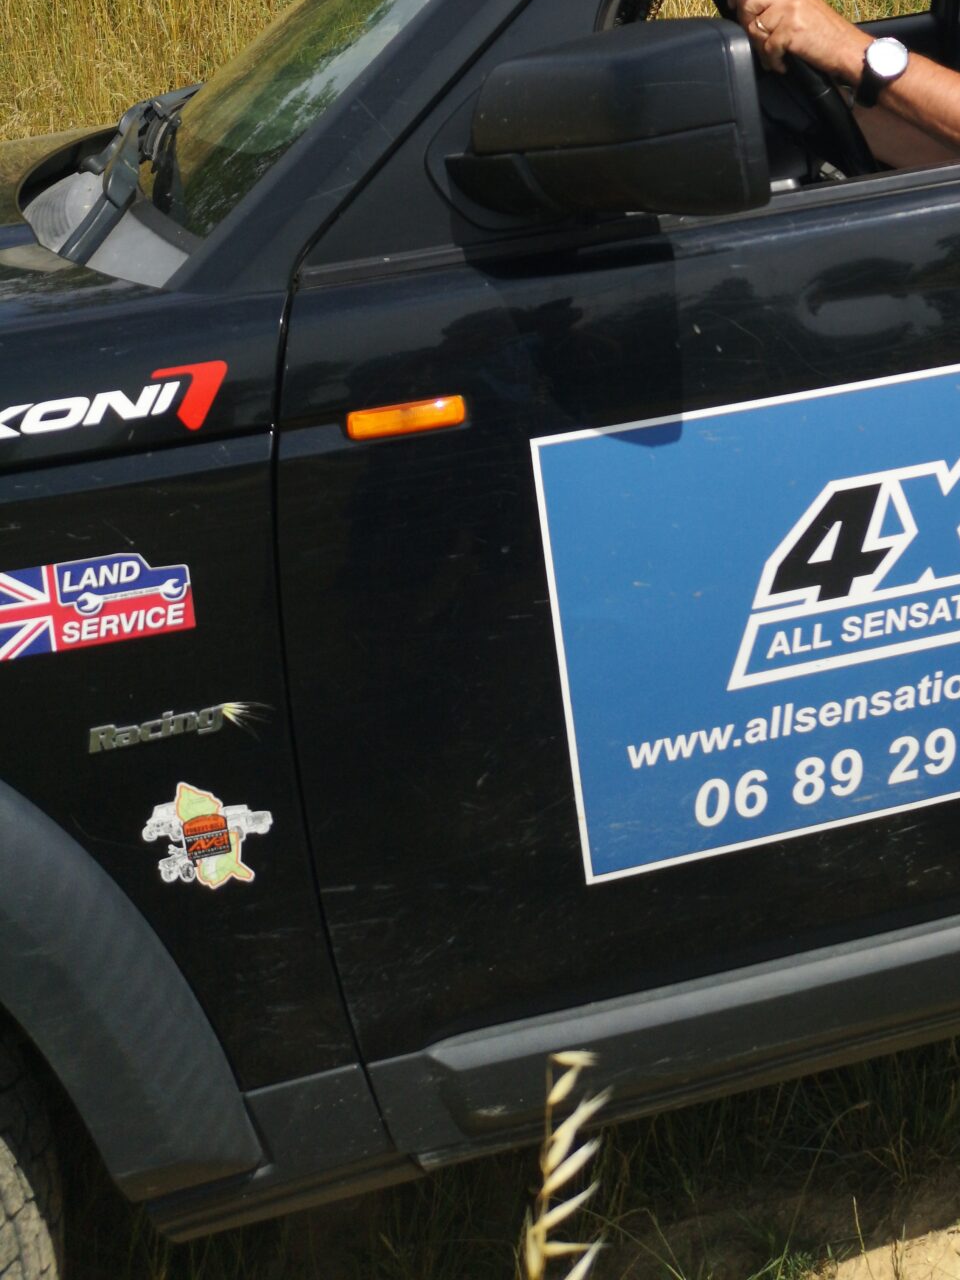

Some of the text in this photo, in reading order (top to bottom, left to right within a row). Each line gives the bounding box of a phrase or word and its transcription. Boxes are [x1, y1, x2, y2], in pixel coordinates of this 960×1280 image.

[62, 560, 141, 593] LAND
[62, 602, 186, 644] SERVICE
[766, 623, 832, 660] ALL
[88, 703, 224, 754] Racing
[694, 769, 769, 828] 06
[791, 748, 864, 806] 89
[887, 727, 957, 785] 29
